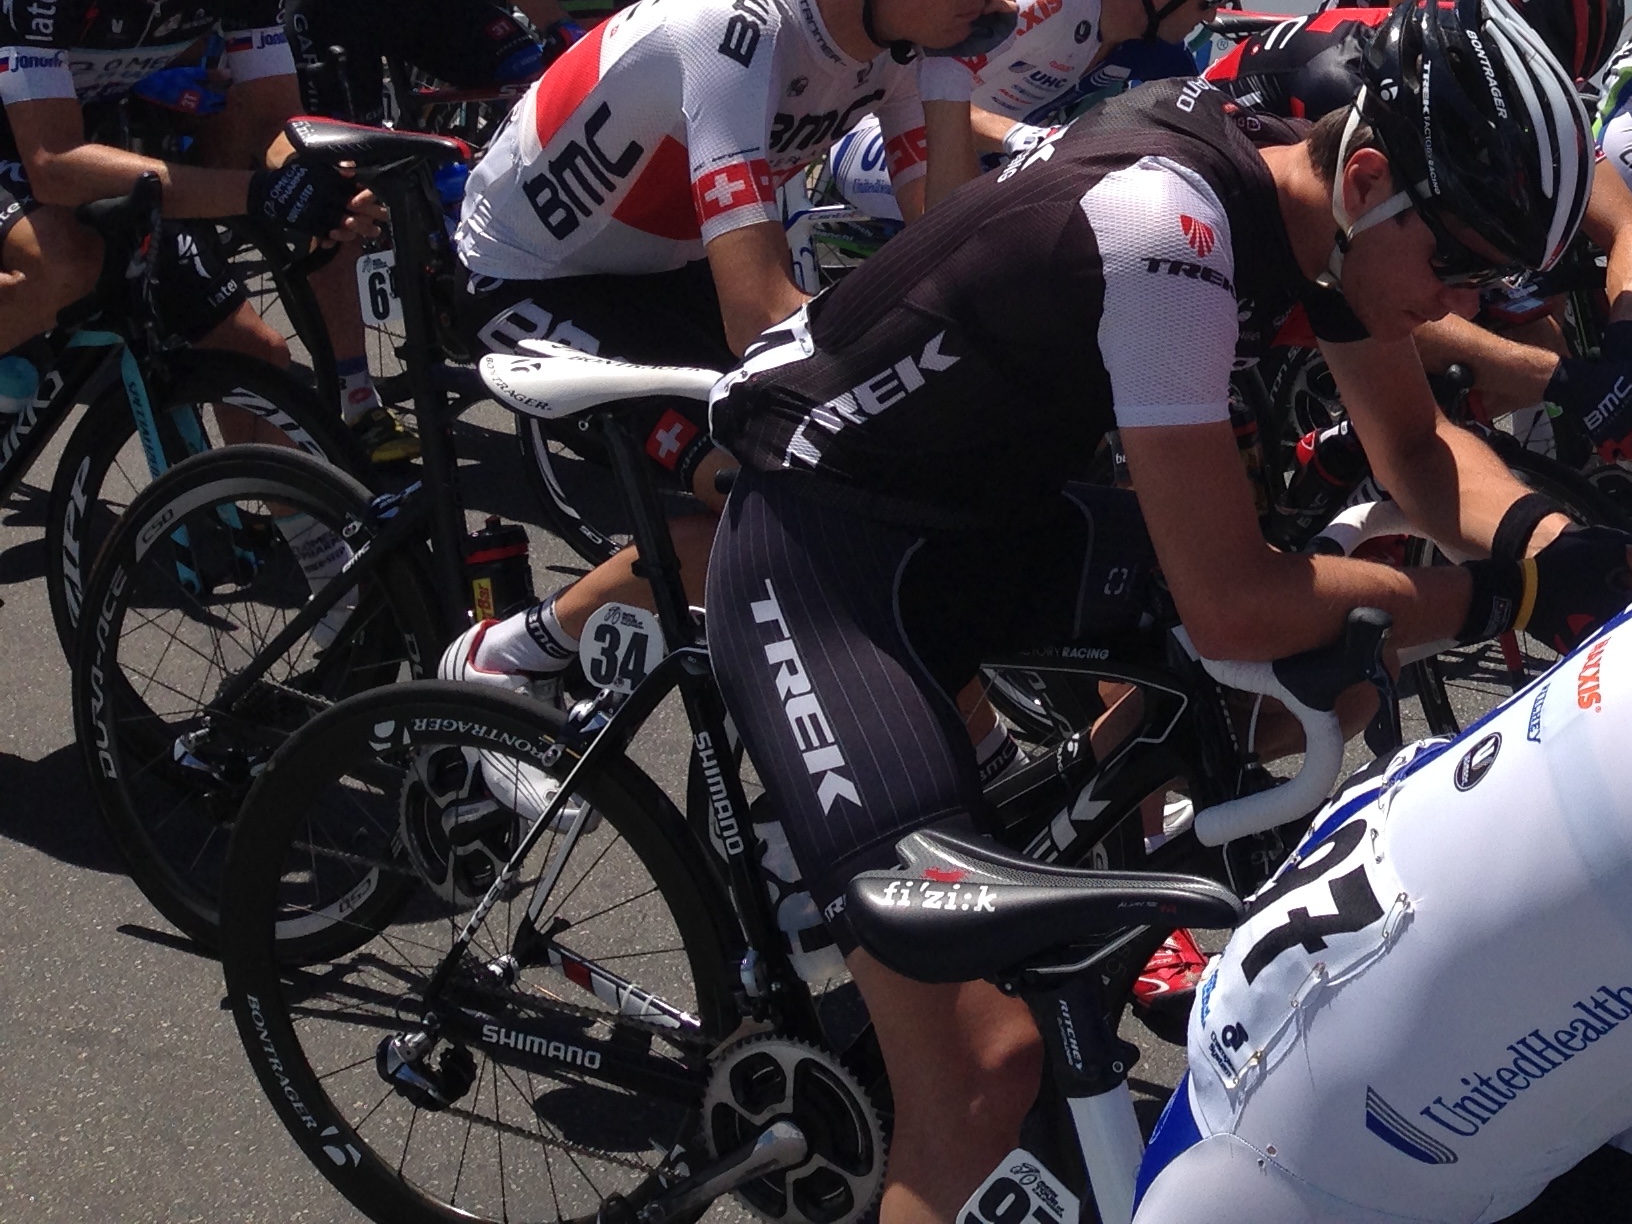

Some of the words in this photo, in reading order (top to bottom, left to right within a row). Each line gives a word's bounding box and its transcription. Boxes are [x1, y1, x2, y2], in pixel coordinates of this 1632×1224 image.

[1030, 70, 1067, 89] UHC
[1466, 29, 1508, 119] BONTRAGER
[522, 101, 644, 241] BMC
[1427, 158, 1441, 195] RACING
[367, 272, 391, 321] 6
[485, 356, 553, 411] BONTRAGER
[782, 330, 961, 468] TREK
[141, 508, 175, 544] C50
[590, 624, 649, 690] 34
[1062, 647, 1110, 660] RACING
[748, 578, 862, 816] TREK
[693, 730, 745, 856] SHIMANO
[247, 993, 318, 1133] BONTRAGER
[482, 1023, 602, 1070] SHIMANO
[1058, 998, 1083, 1072] RITCHEY
